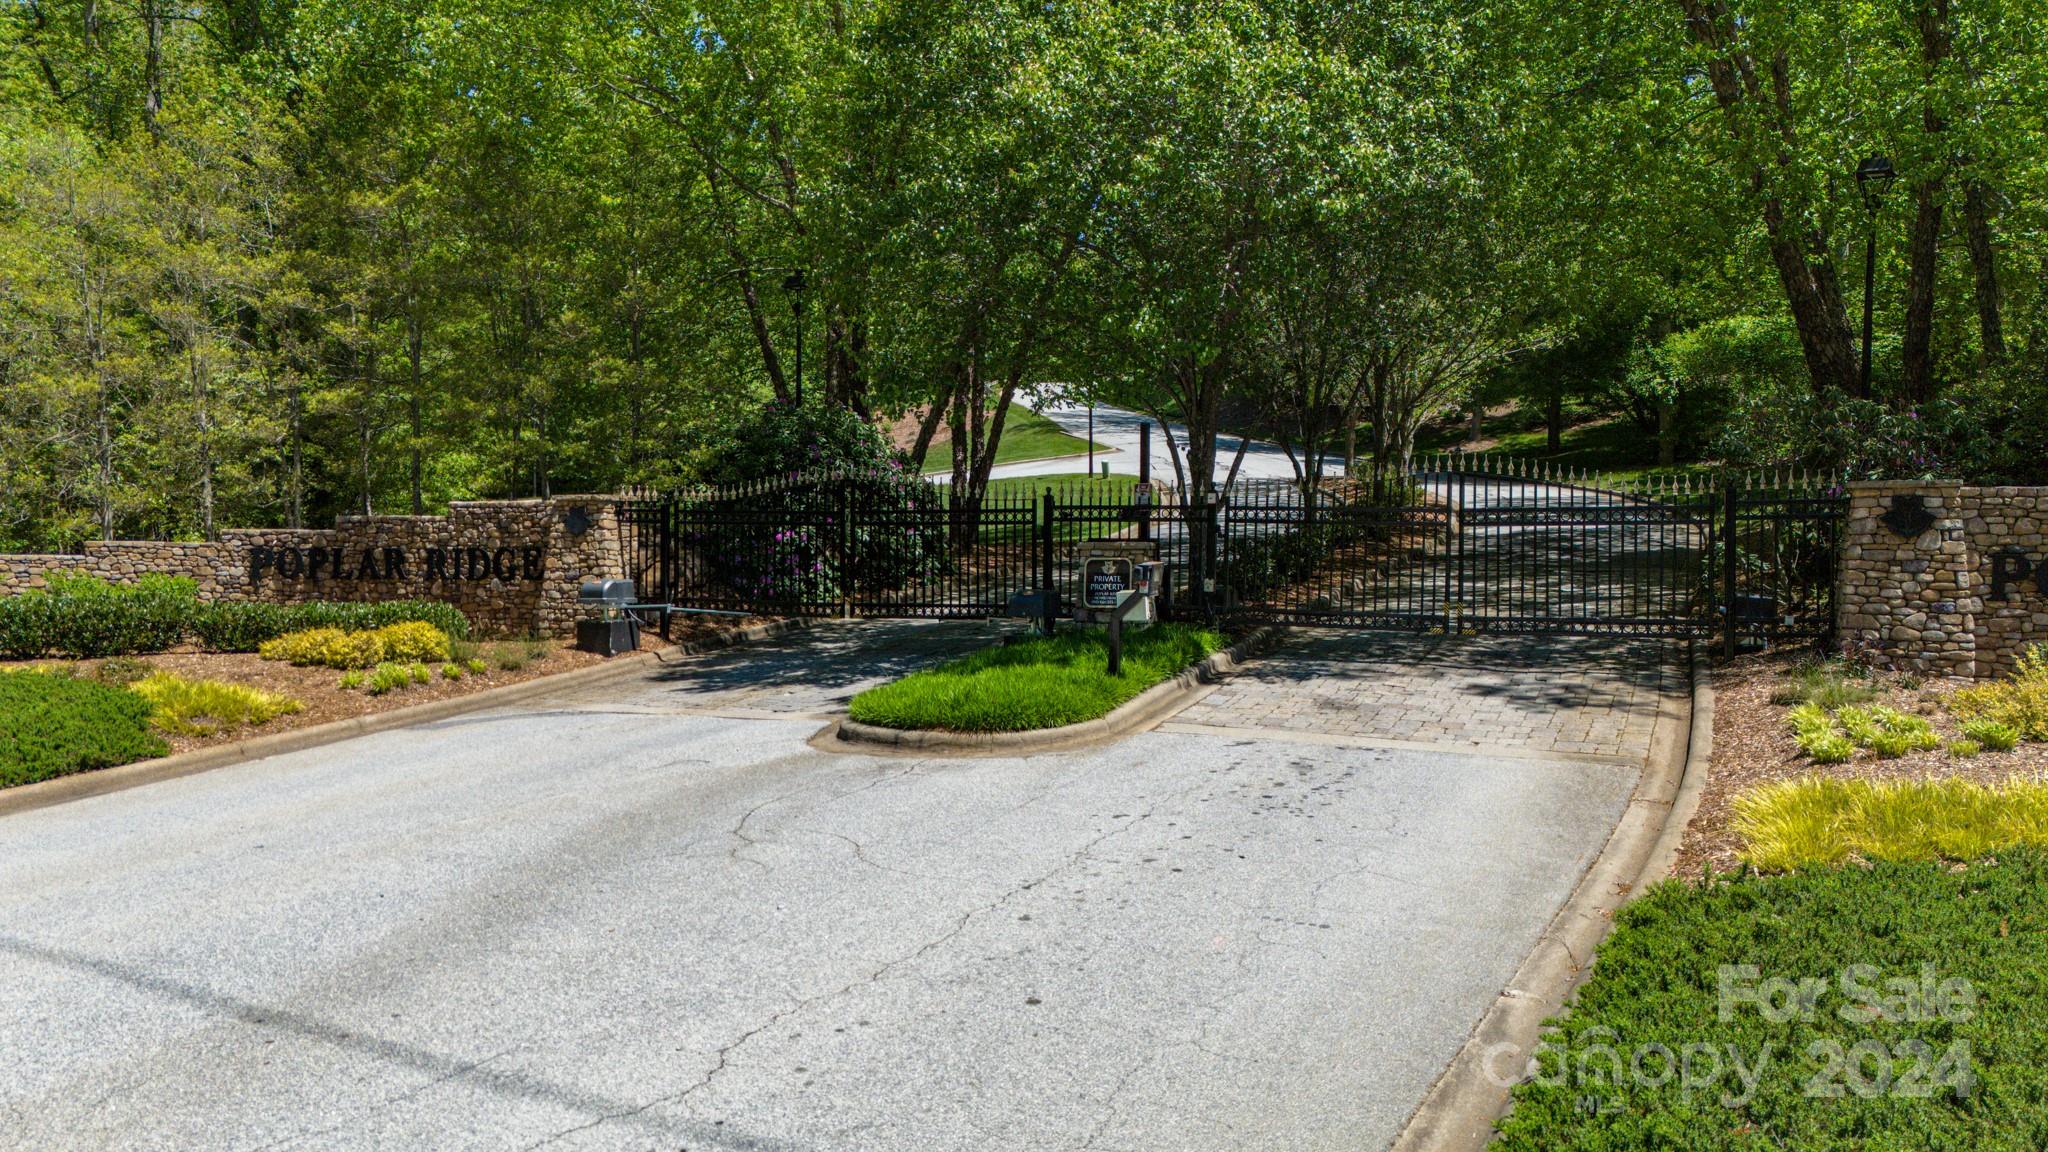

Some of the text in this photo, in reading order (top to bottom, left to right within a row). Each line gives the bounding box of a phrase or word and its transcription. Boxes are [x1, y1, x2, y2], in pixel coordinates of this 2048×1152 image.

[250, 547, 545, 583] POPLAR RIDGE
[1090, 583, 1125, 591] PROPERTY
